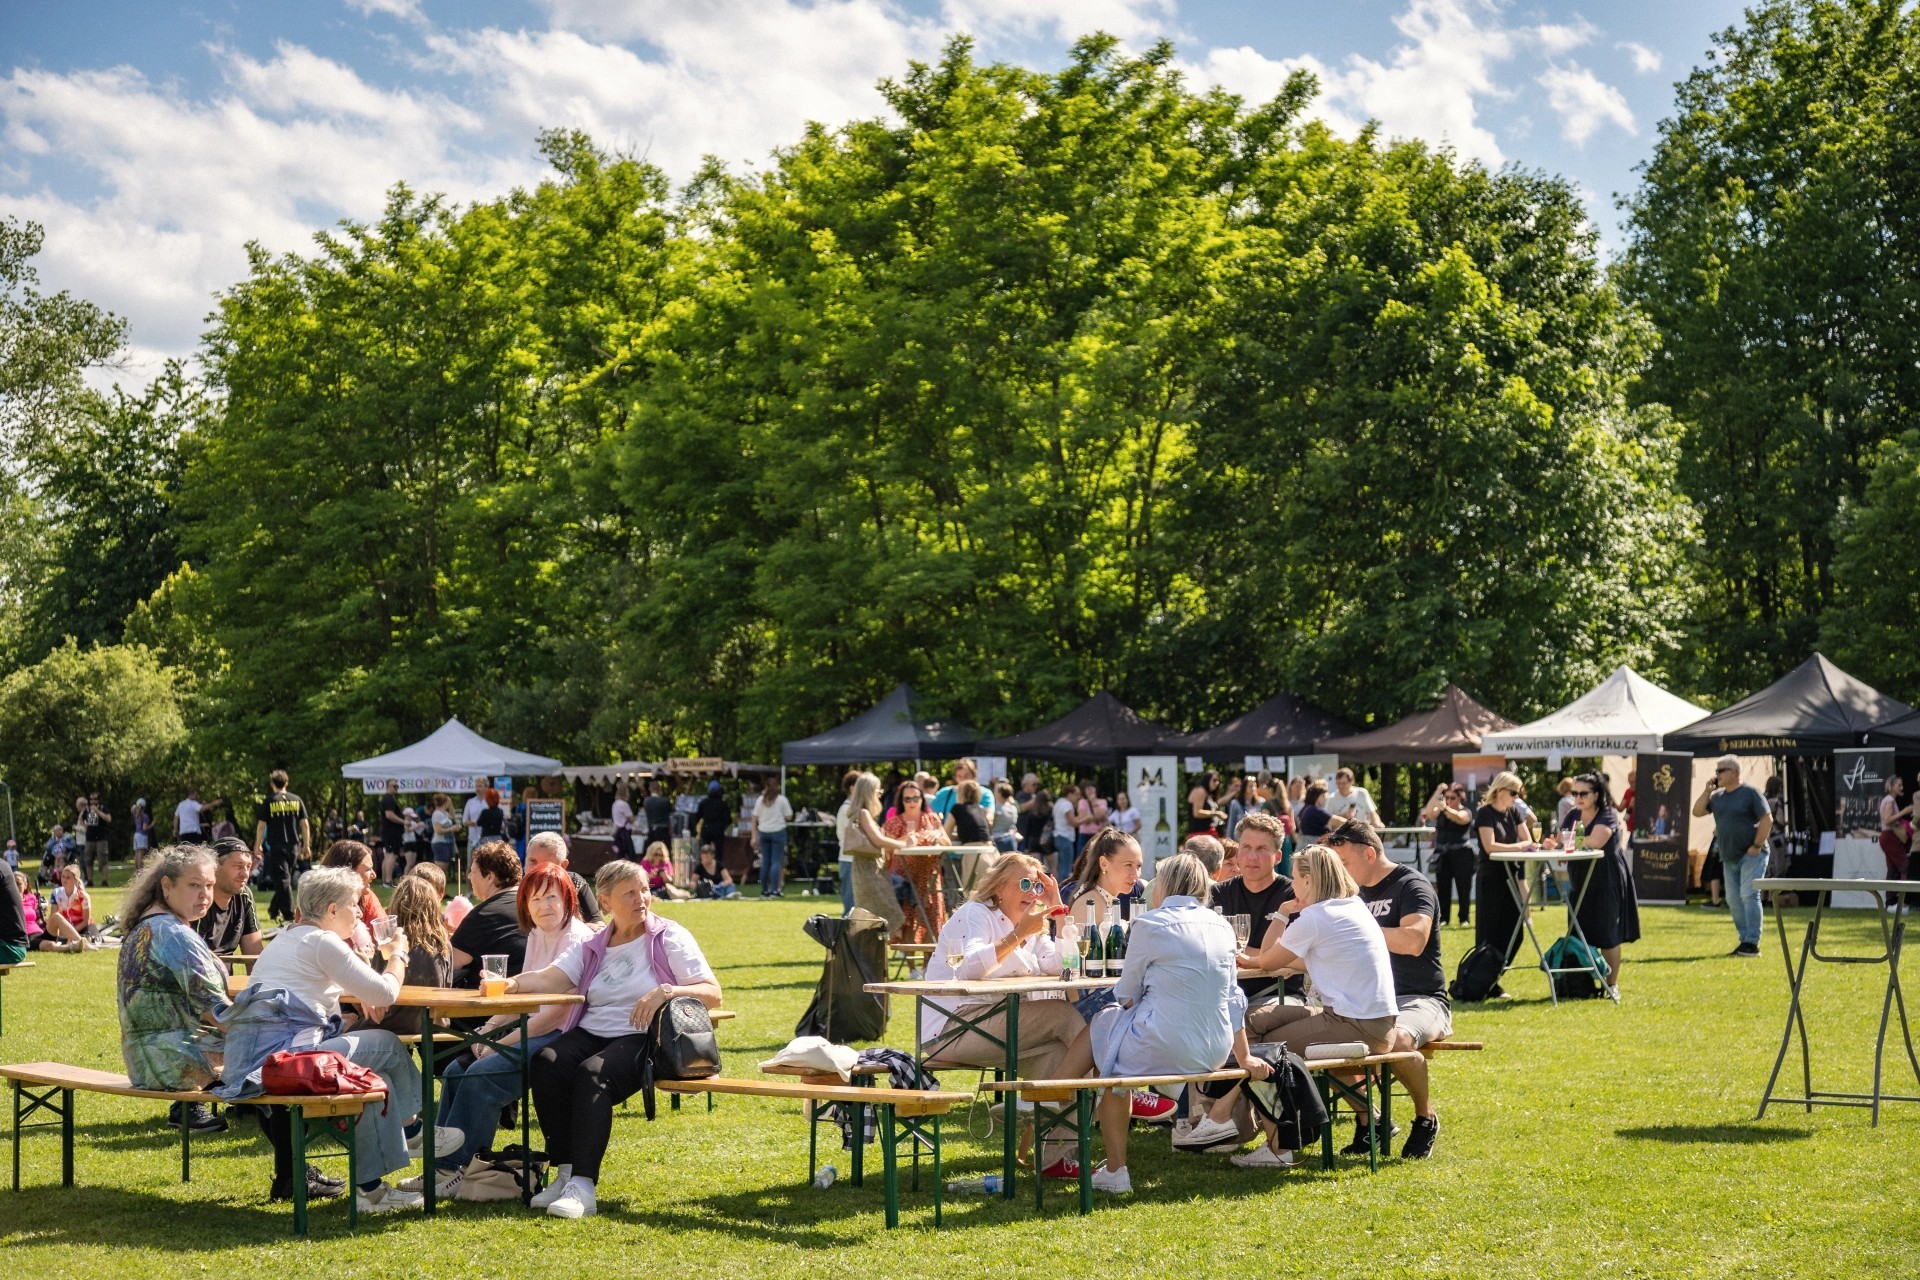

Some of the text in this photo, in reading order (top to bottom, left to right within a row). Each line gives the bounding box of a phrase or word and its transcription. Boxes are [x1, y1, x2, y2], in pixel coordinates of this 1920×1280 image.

[1496, 736, 1639, 752] www.vinarstviukrizku.cz
[365, 779, 431, 791] WOSHOP
[434, 779, 456, 789] PRO
[1136, 766, 1168, 788] M
